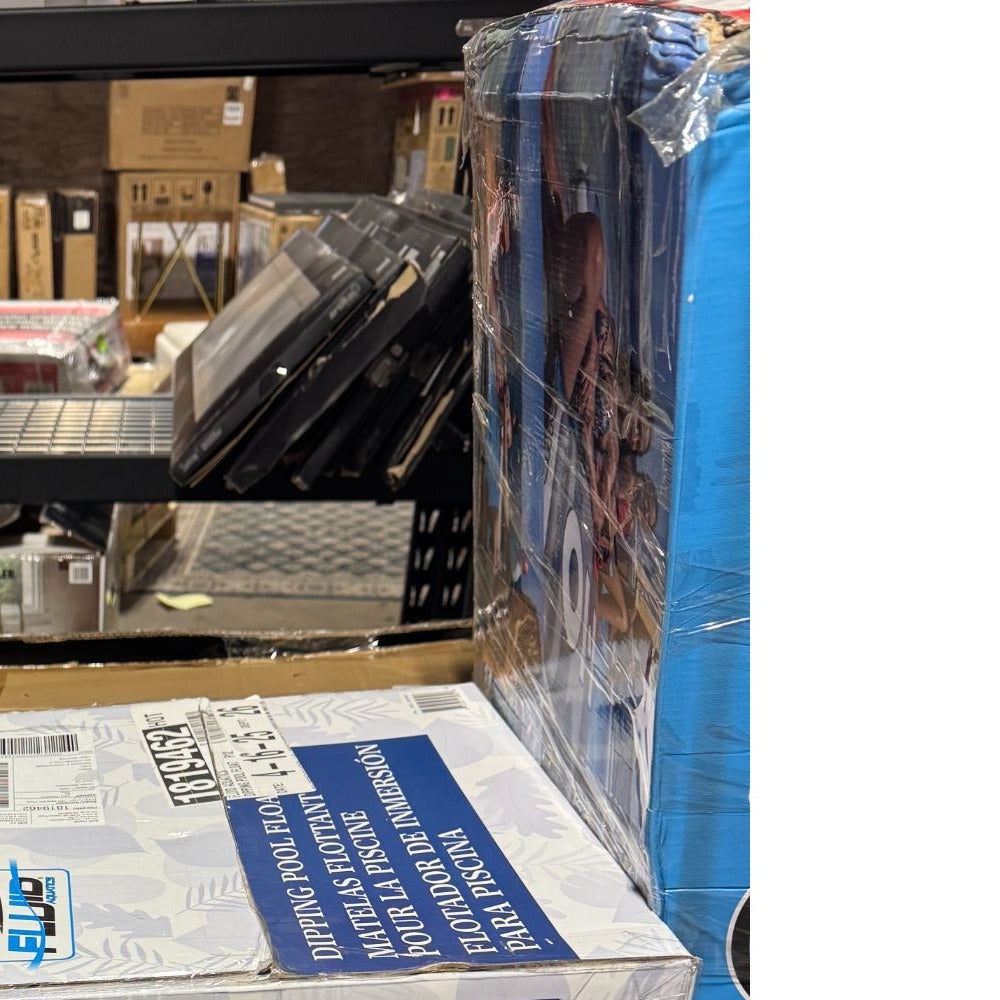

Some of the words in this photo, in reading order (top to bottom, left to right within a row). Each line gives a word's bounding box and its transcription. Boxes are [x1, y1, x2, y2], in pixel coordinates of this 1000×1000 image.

[144, 713, 167, 728] HOT
[217, 706, 260, 717] 26
[146, 726, 220, 804] 1819462
[230, 730, 296, 776] 4-16-25
[255, 794, 290, 834] FLOA
[355, 744, 420, 829] INMERSIÓN
[270, 838, 309, 882] POOL
[298, 794, 355, 874] FLOTTANT
[341, 810, 394, 875] PISCINE
[400, 831, 436, 856] DE
[438, 828, 504, 898] PISCINA
[8, 877, 56, 953] FLUID
[333, 877, 398, 959] MATELAS
[374, 878, 408, 902] LA
[415, 858, 498, 954] FLOTADOR
[287, 887, 343, 961] DIPPING
[387, 905, 441, 958] POUR
[482, 902, 542, 952] PARA
